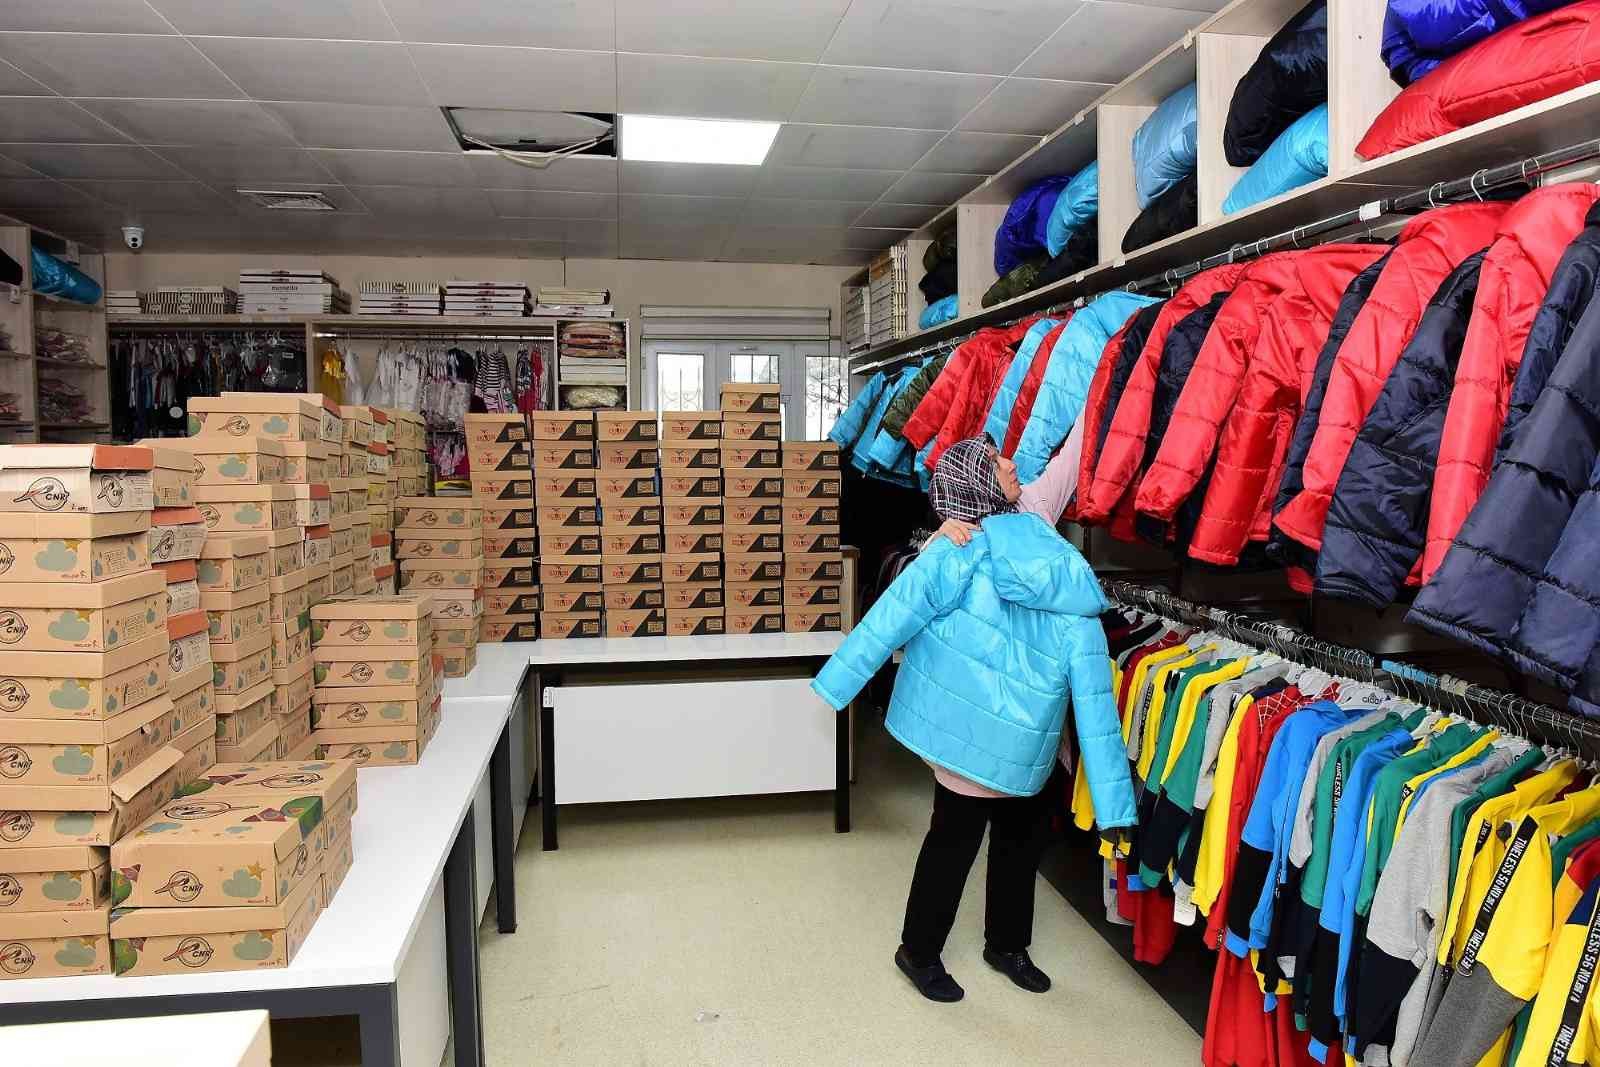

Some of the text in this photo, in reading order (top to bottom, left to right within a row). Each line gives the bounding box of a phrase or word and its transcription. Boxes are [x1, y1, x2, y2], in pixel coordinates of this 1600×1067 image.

[45, 493, 66, 501] CNR
[10, 761, 31, 769] CNR
[1501, 837, 1527, 876] TIMELESS
[1495, 873, 1509, 888] 56
[182, 885, 202, 893] CNR
[1582, 954, 1596, 969] 56
